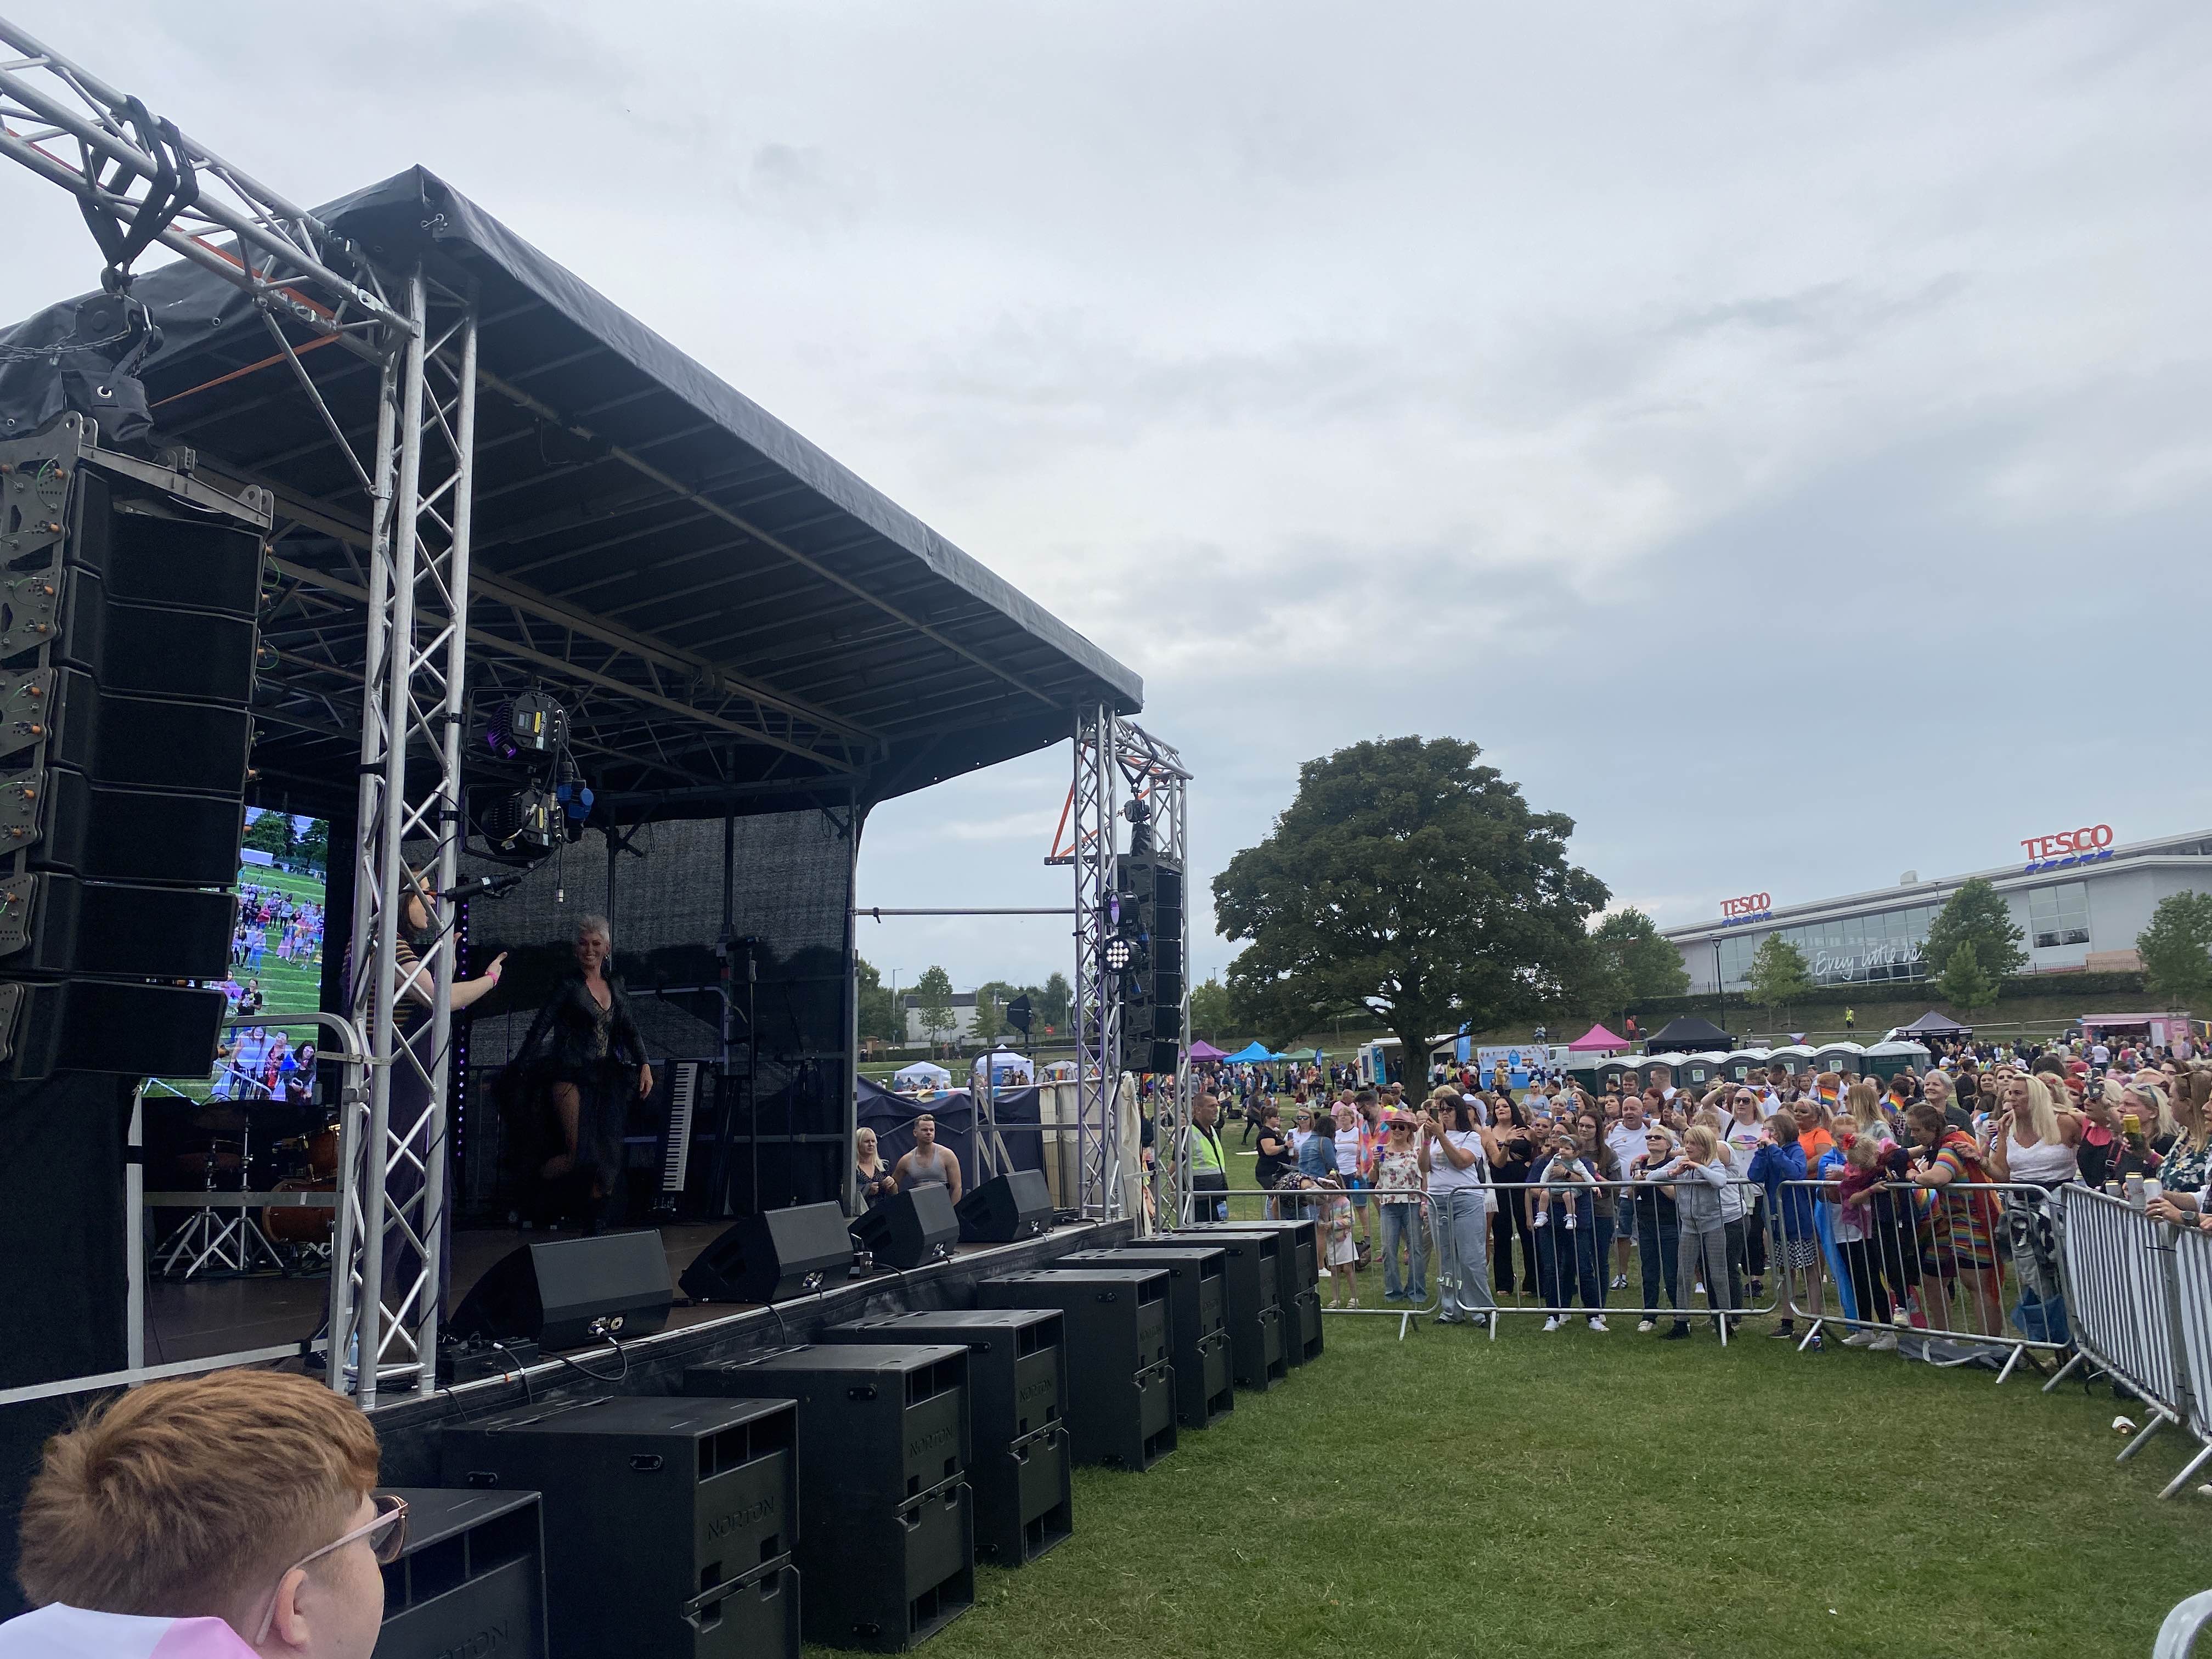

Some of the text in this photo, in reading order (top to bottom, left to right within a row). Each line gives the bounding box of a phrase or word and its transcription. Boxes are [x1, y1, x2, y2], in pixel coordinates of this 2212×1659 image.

[2021, 825, 2113, 860] TESCO
[1720, 892, 1770, 916] TESCO
[1816, 951, 1854, 980] Every
[1861, 944, 1896, 967] little
[910, 1424, 953, 1458] NORTON
[708, 1496, 774, 1543] NORTON
